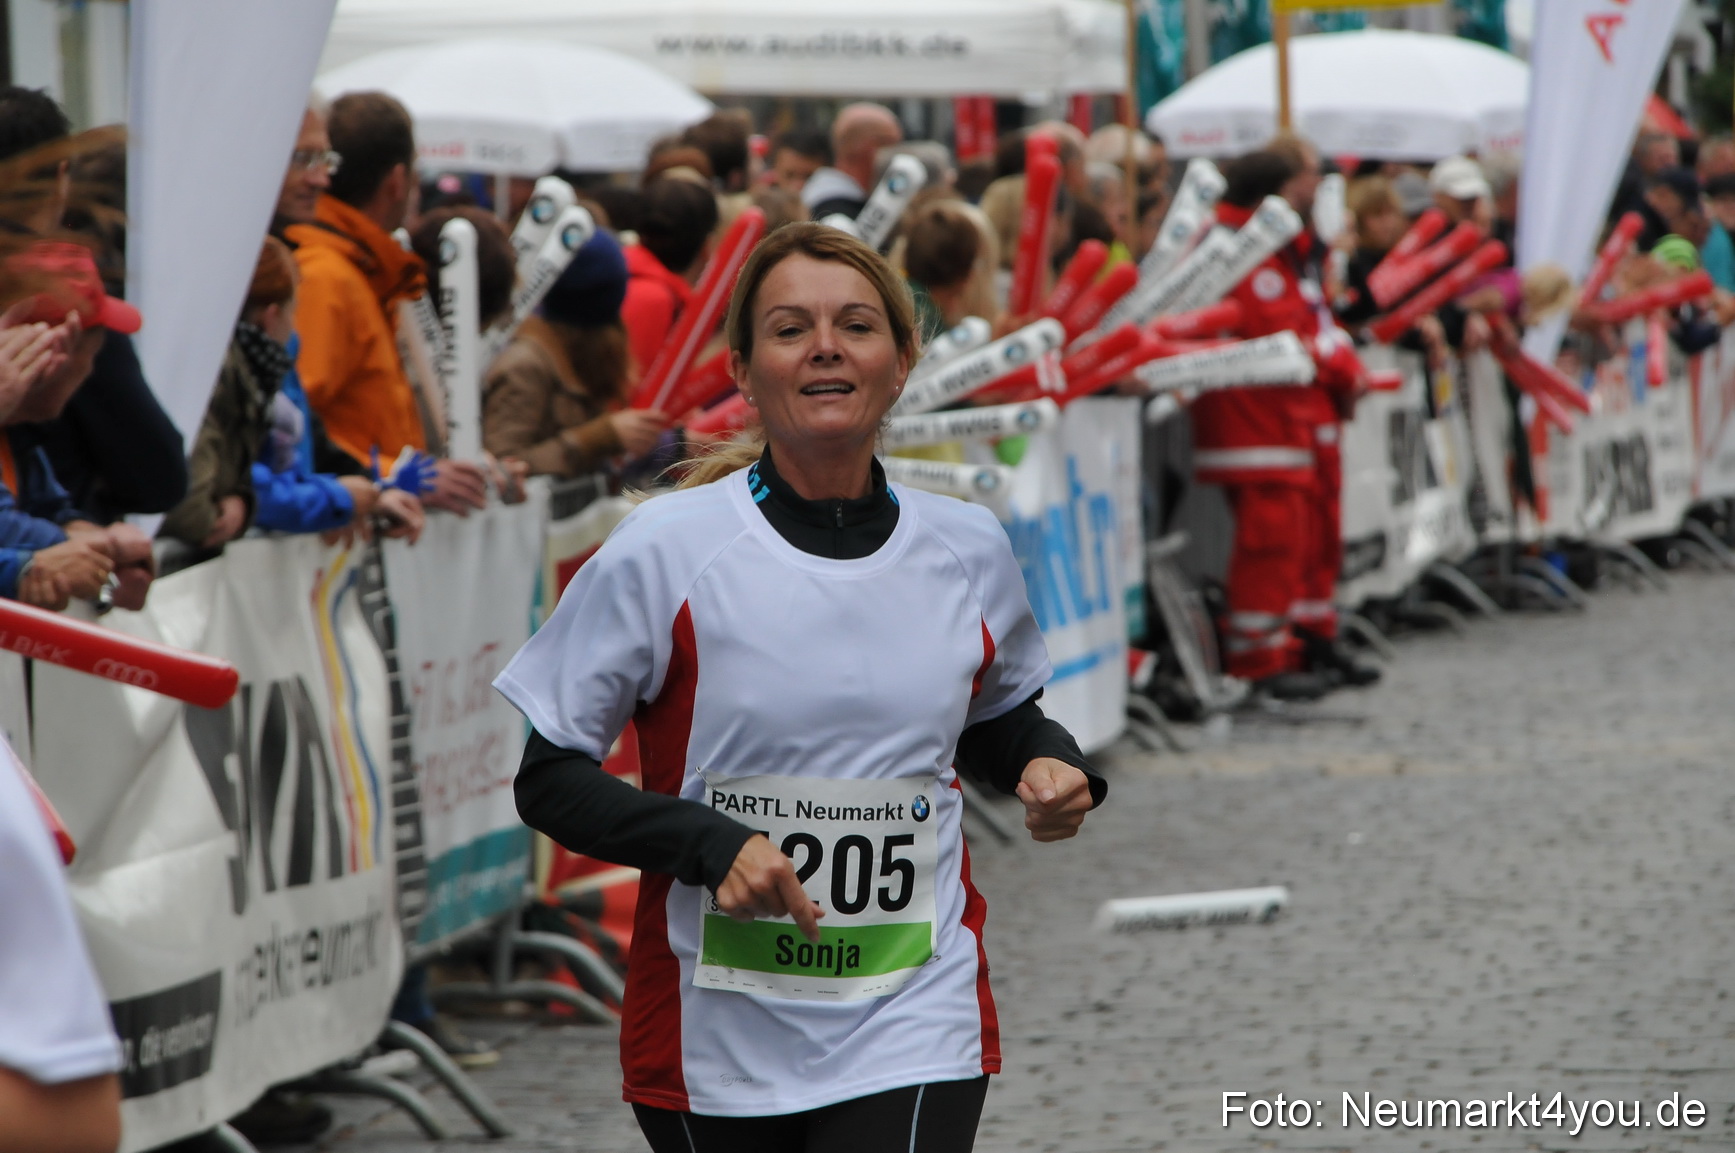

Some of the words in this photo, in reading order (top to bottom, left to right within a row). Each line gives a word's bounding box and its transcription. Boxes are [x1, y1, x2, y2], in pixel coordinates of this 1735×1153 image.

[711, 789, 789, 818] PARTL
[795, 799, 904, 821] Neumarkt
[755, 830, 915, 916] 205
[775, 934, 861, 976] Sonja
